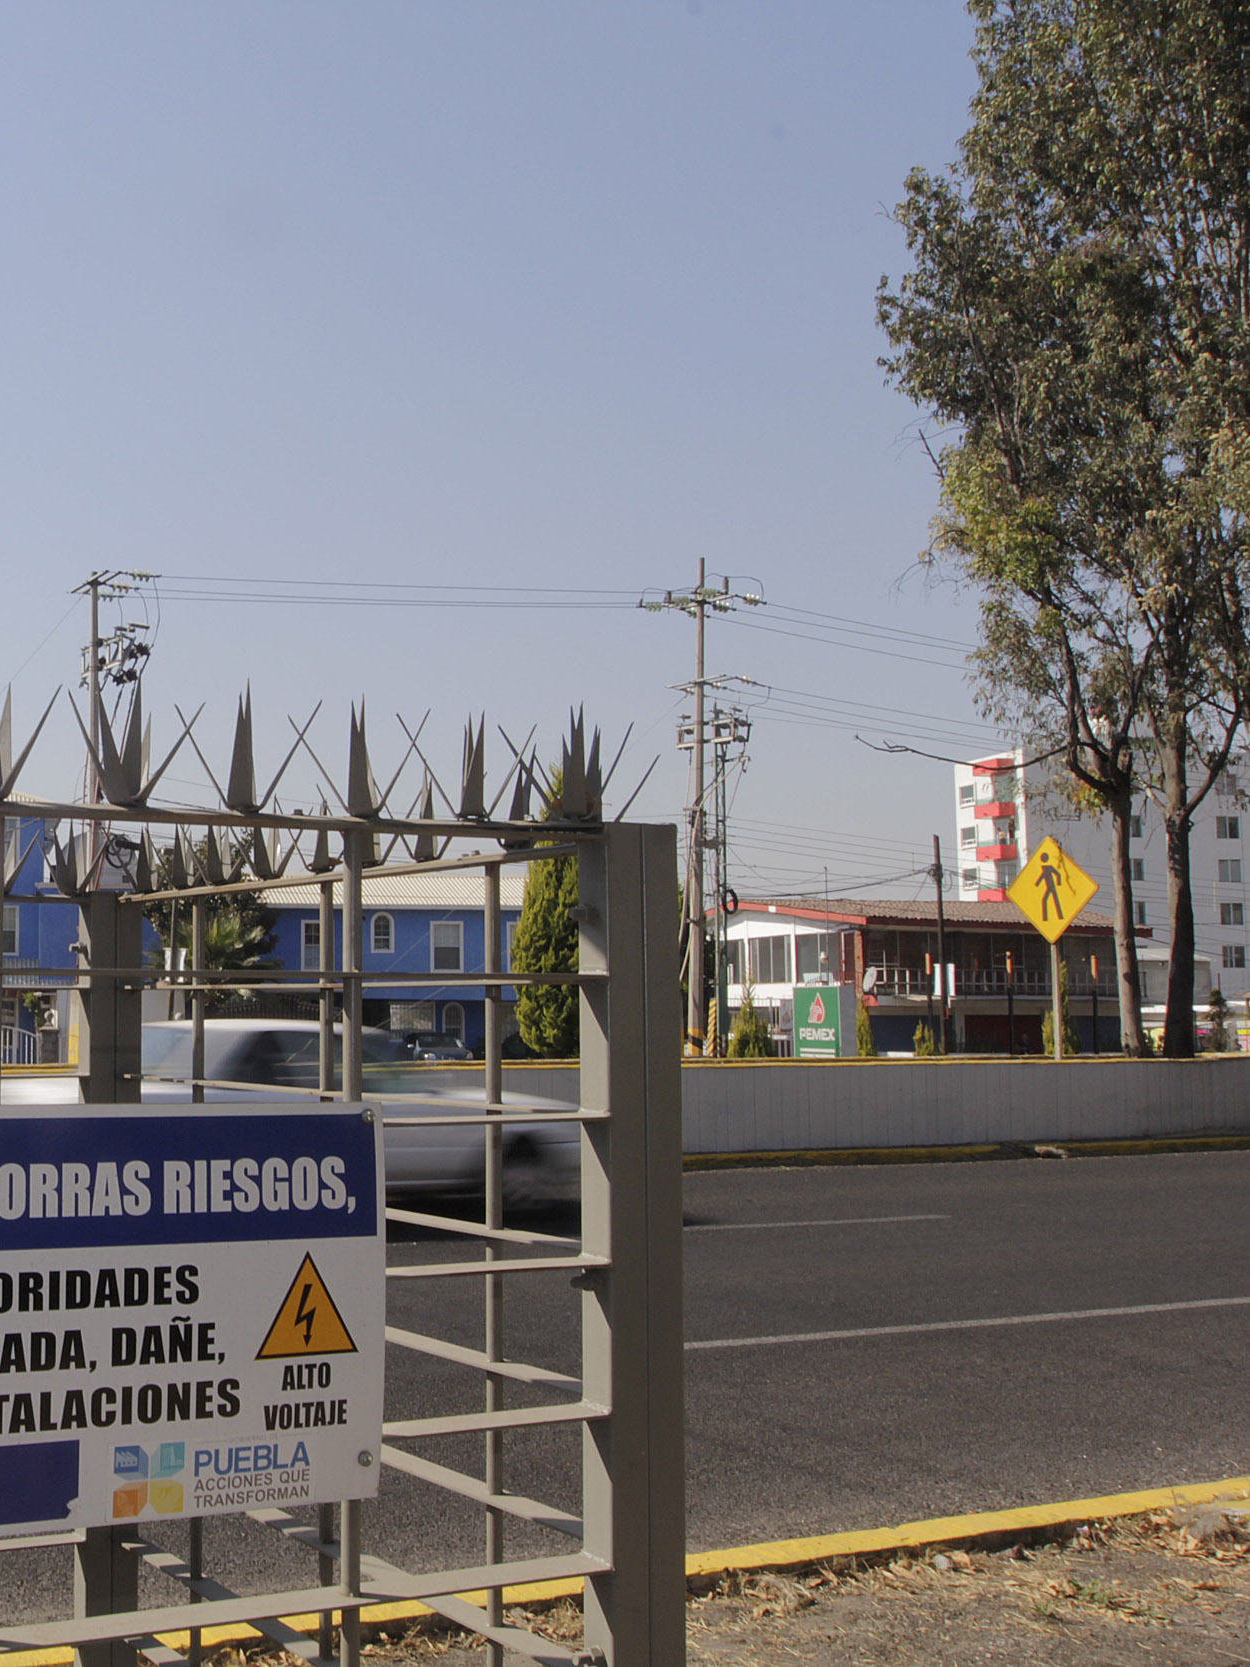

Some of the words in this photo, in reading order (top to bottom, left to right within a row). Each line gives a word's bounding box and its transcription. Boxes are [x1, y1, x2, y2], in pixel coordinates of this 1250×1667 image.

[799, 1027, 836, 1042] PEMEX
[163, 1155, 356, 1214] RIESGOS,
[111, 1315, 226, 1367] DAÑE,
[281, 1361, 332, 1392] ALTO
[263, 1398, 348, 1431] VOLTAJE
[193, 1440, 311, 1477] PUEBLA
[193, 1484, 310, 1509] TRANSFORMAN
[194, 1473, 273, 1493] ACCIONES
[279, 1468, 311, 1485] QUE
